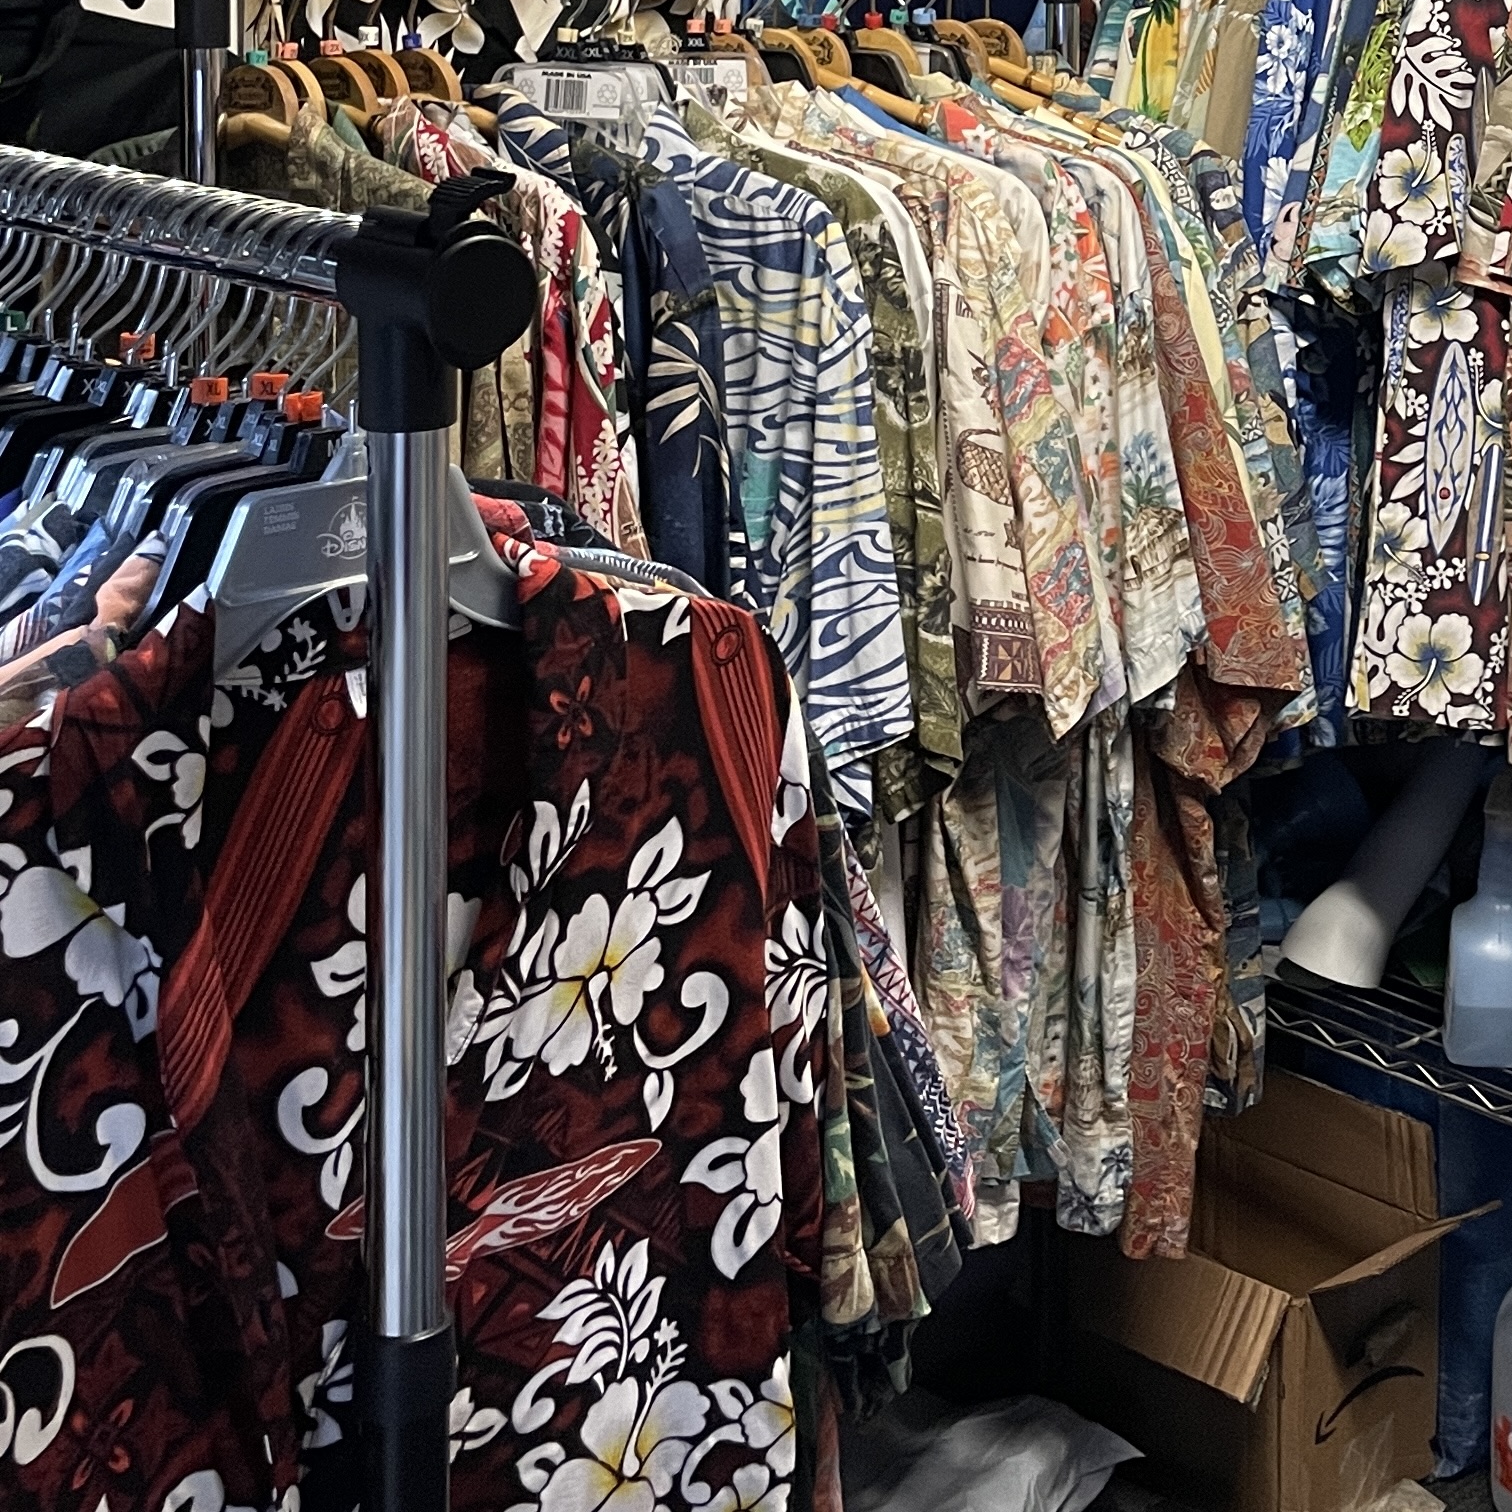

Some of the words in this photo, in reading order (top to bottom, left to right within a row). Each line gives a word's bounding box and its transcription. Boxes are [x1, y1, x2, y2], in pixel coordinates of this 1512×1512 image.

[329, 43, 340, 52] 2X
[687, 37, 705, 47] XXL
[6, 316, 18, 331] L
[206, 381, 221, 395] XL
[261, 381, 278, 396] XL
